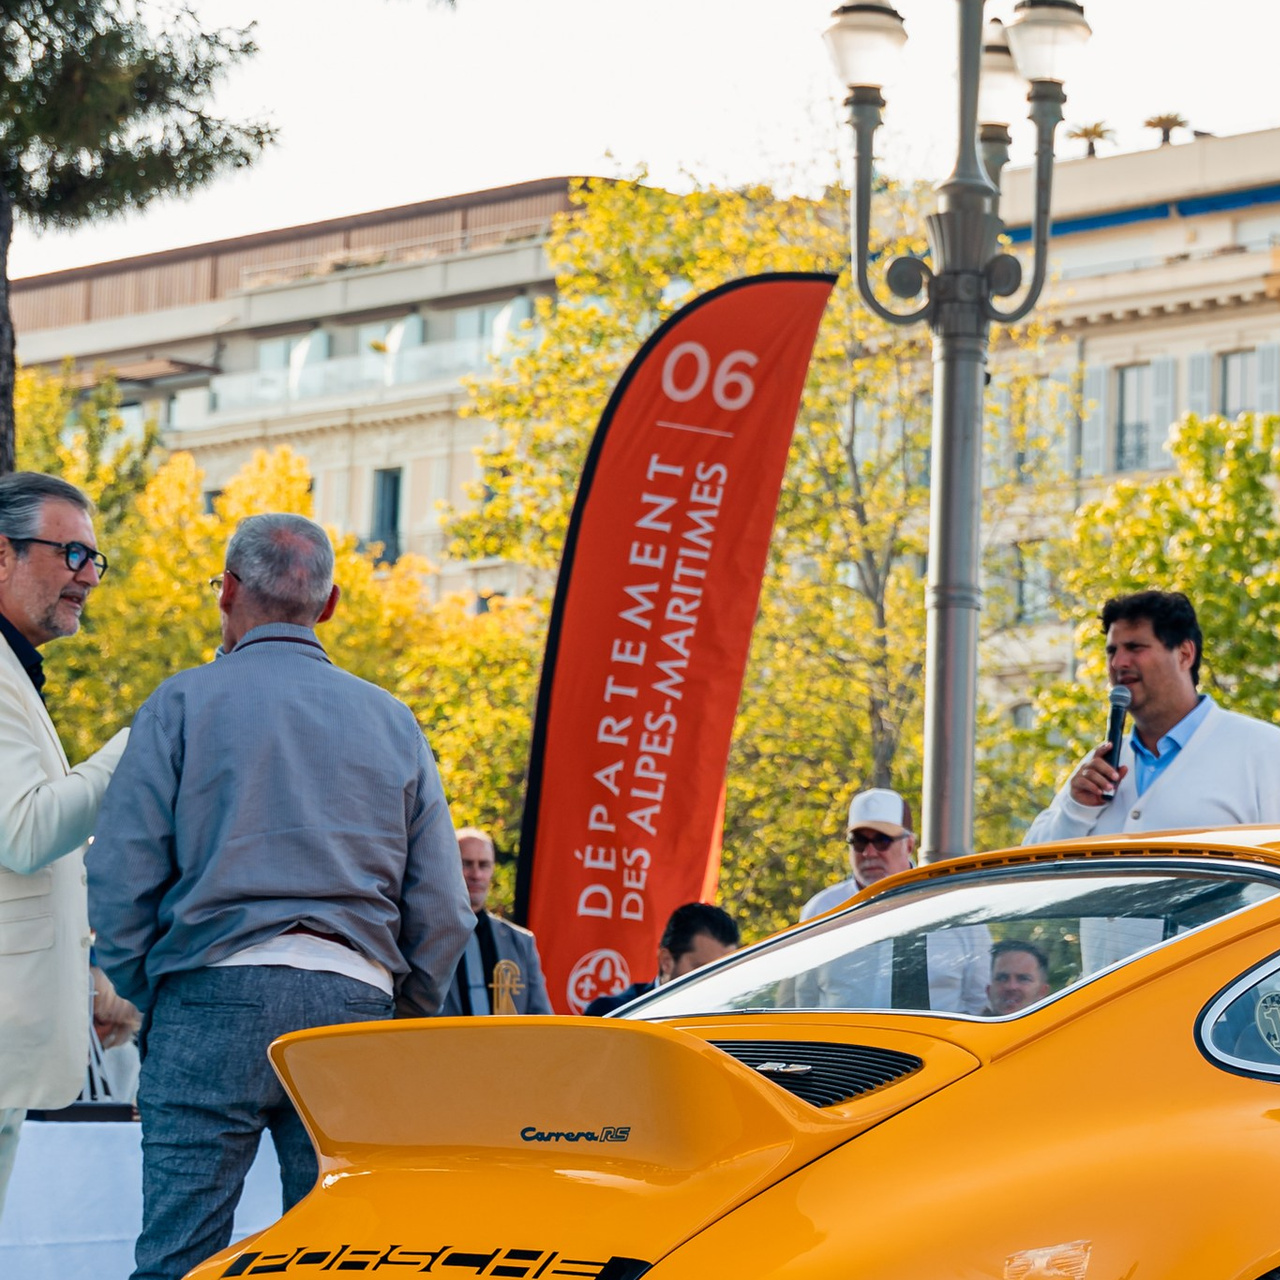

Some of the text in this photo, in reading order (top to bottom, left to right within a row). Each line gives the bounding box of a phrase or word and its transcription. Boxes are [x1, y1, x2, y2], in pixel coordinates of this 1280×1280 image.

[661, 341, 760, 411] 06
[574, 453, 685, 919] DÉPARTEMENT
[620, 461, 728, 922] DES ALPES-MARITIMES
[520, 1126, 631, 1142] Carrera RS
